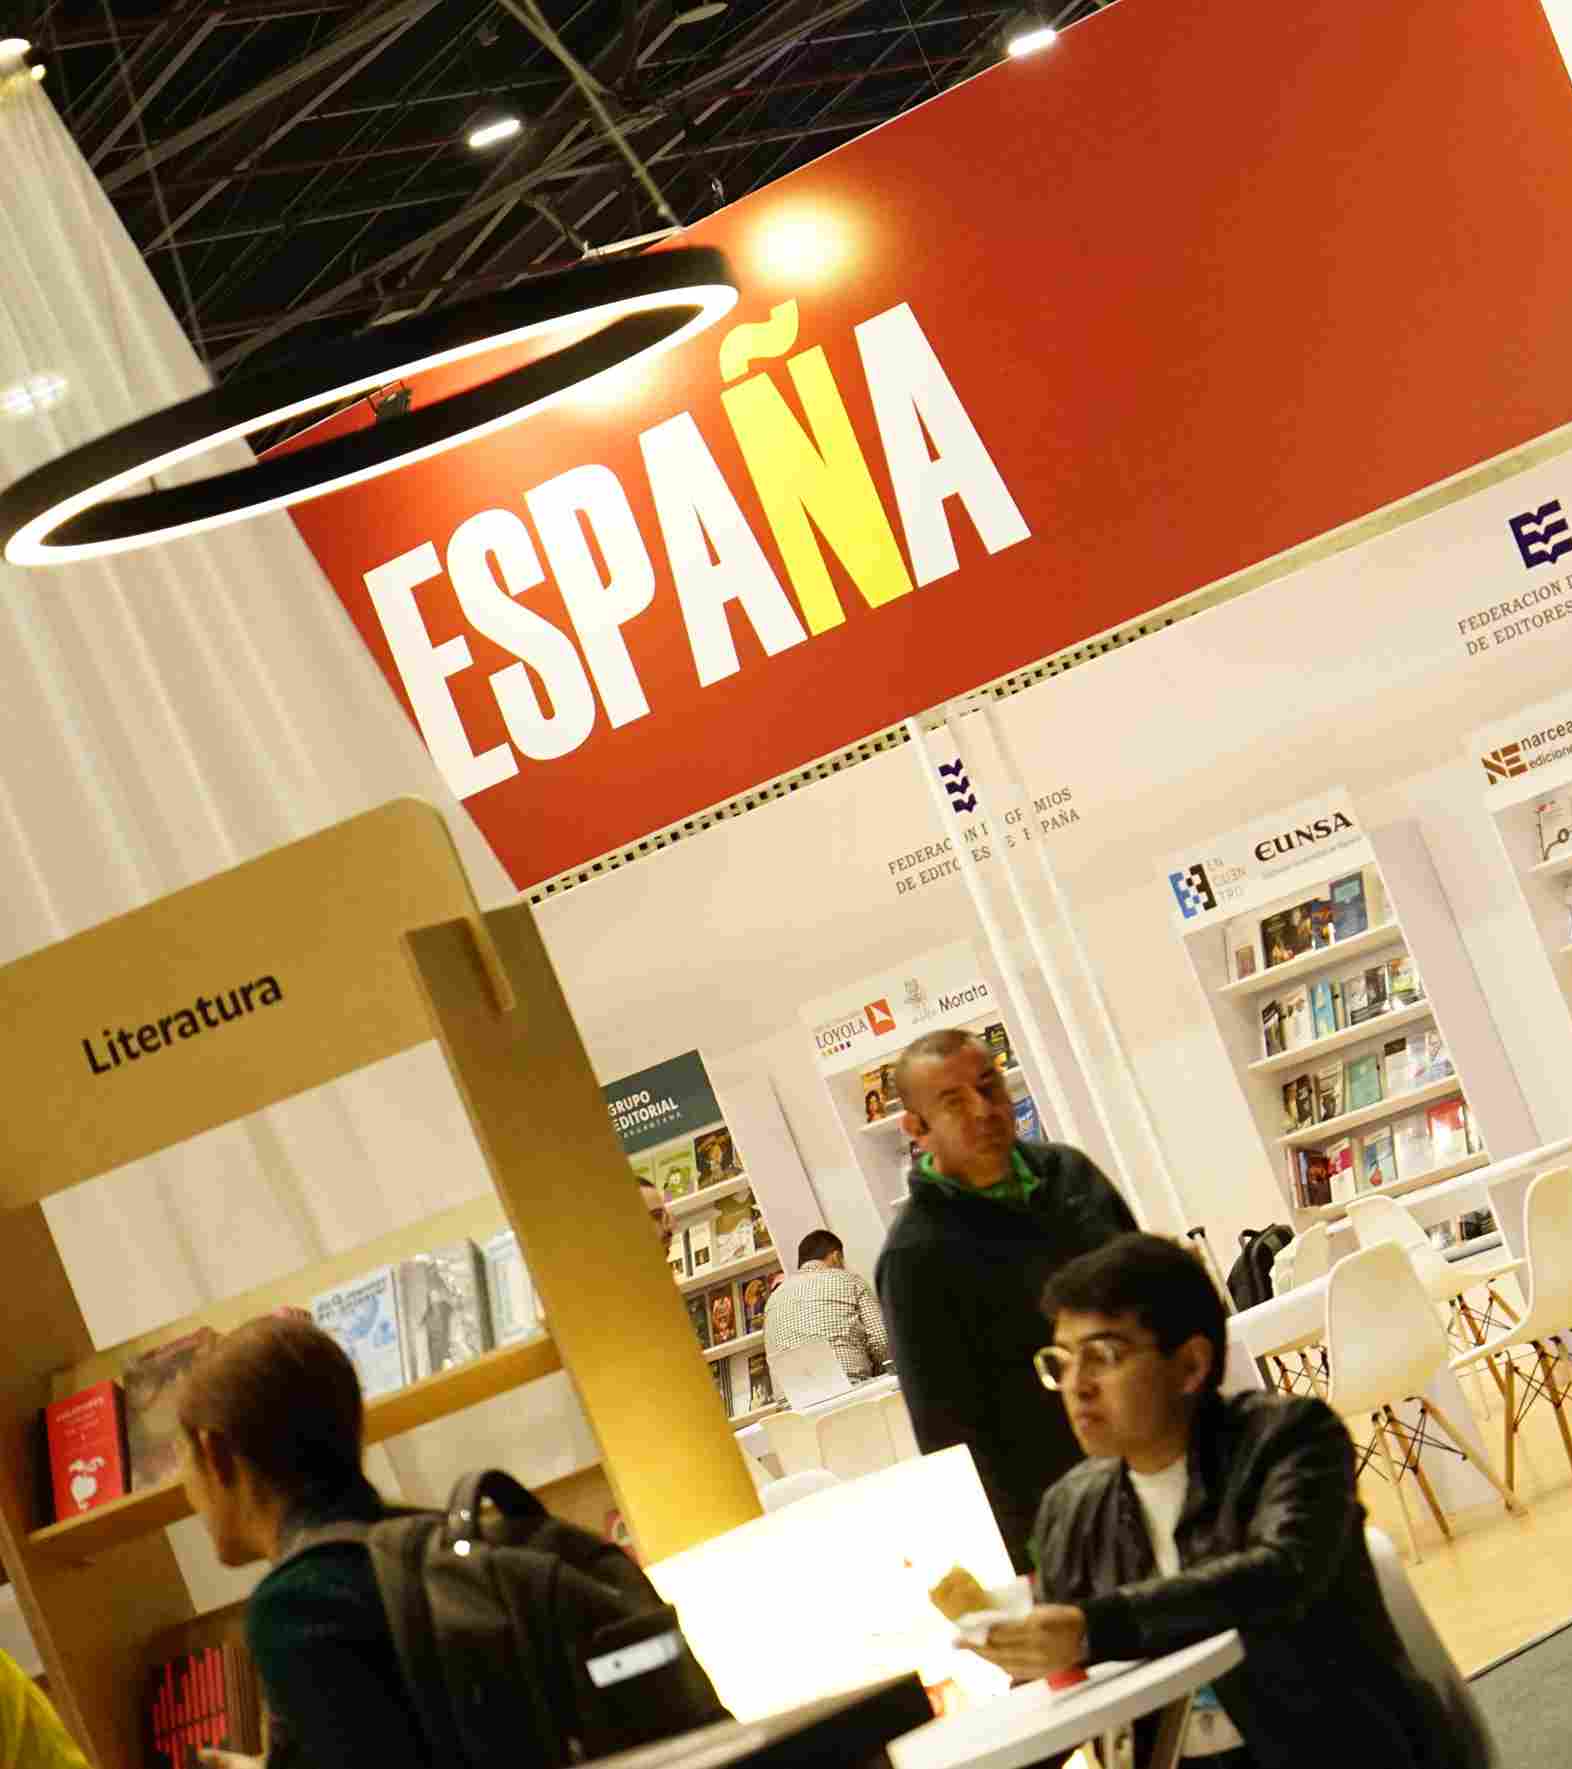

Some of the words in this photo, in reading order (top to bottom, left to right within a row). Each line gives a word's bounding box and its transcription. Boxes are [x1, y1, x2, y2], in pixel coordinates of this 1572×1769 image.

[362, 299, 1033, 801] ESPAÑA
[1465, 635, 1491, 657] DE
[887, 826, 978, 876] FEDERACN
[1253, 811, 1354, 863] EUNSA
[895, 878, 917, 896] DE
[938, 983, 989, 1015] Morata
[81, 972, 284, 1076] Literatura
[815, 1017, 869, 1050] LOYOLA
[608, 1090, 651, 1117] GRUPO
[614, 1096, 680, 1132] EDITORIAL
